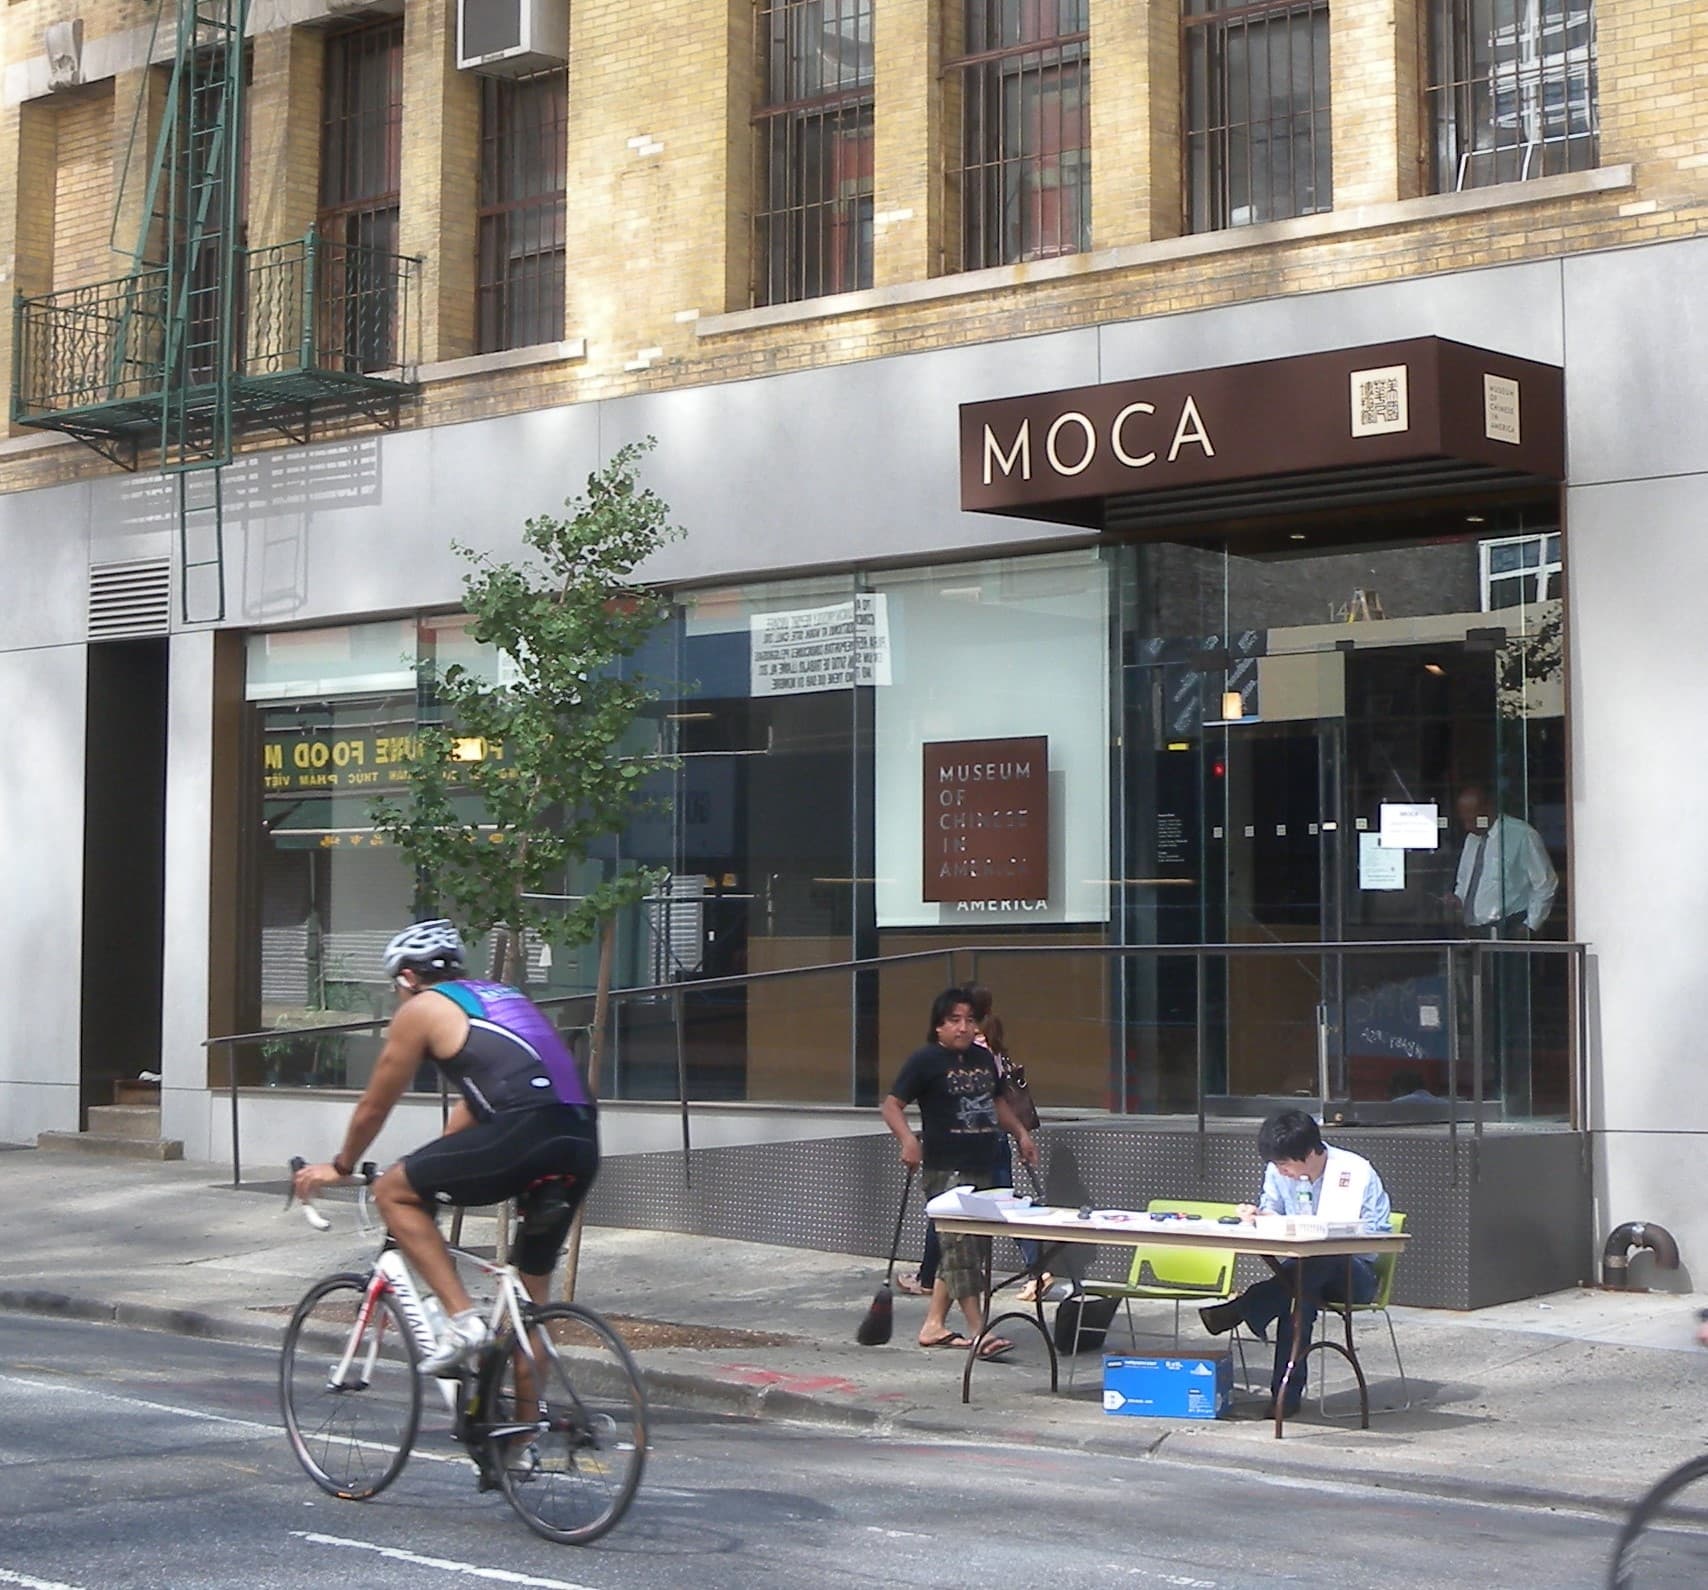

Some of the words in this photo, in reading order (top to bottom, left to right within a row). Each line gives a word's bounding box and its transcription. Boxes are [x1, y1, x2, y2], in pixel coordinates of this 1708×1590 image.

[983, 395, 1216, 485] MOCA
[940, 762, 1031, 783] MUSEUM
[940, 789, 967, 806] OF
